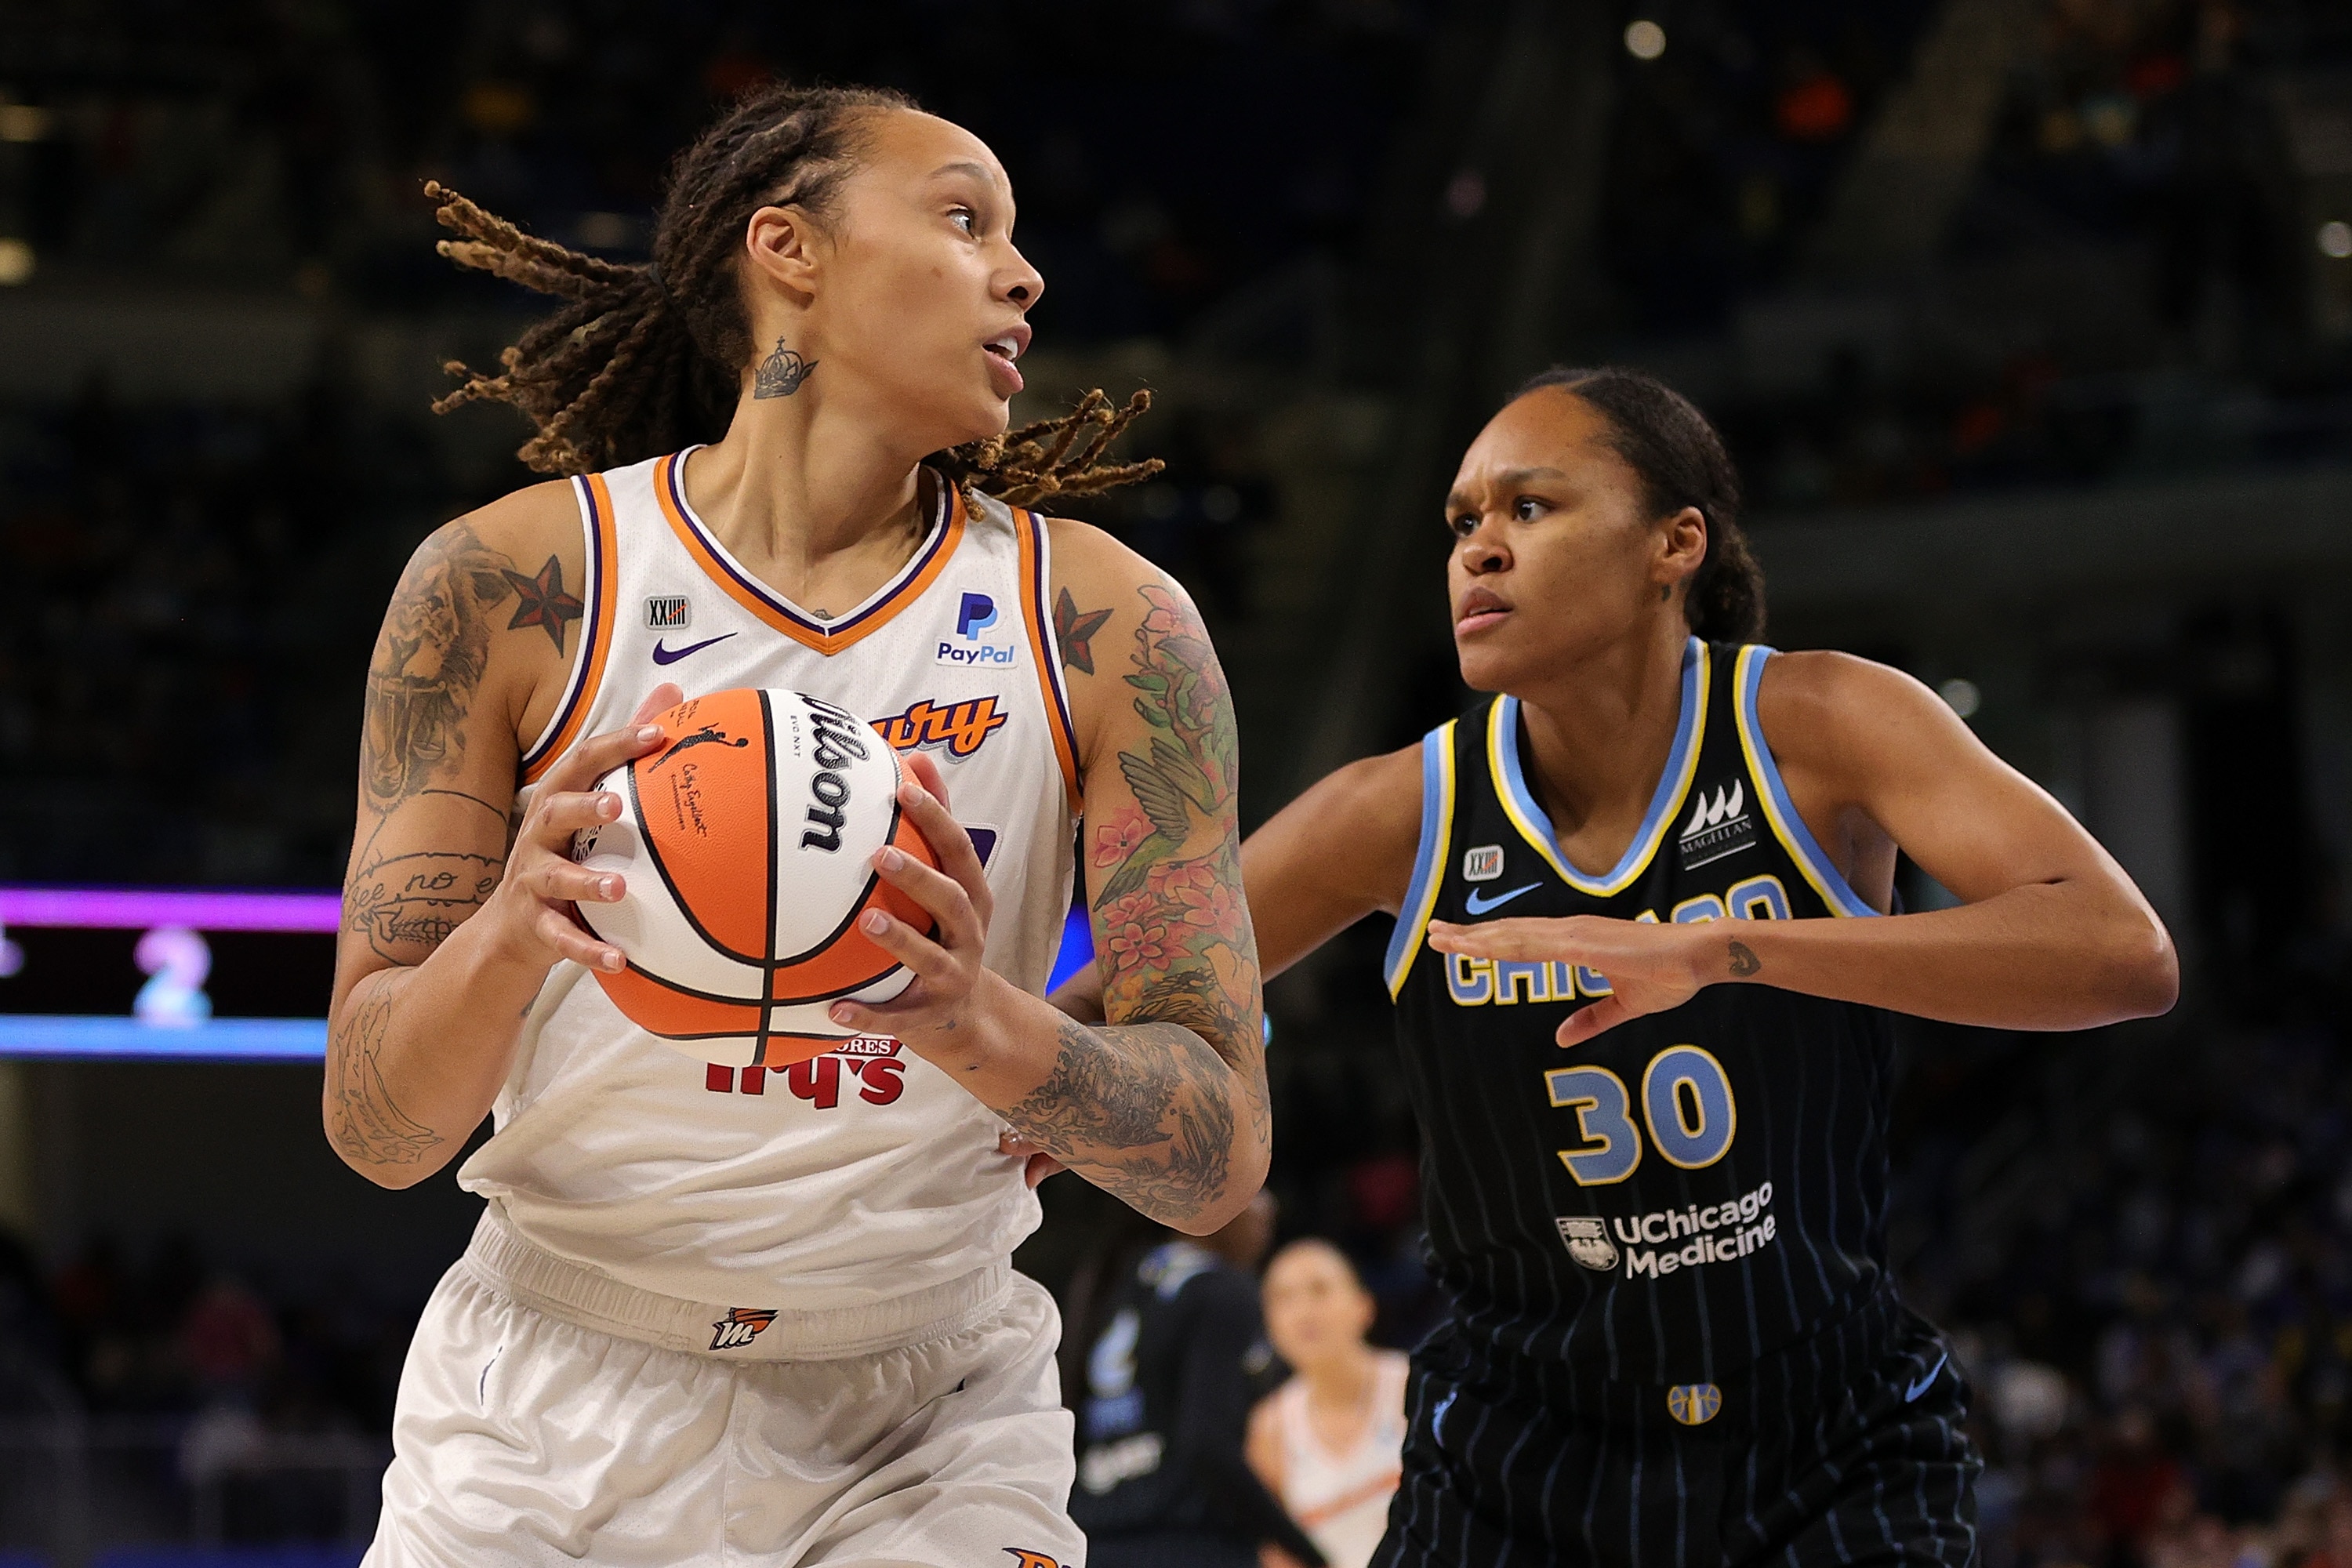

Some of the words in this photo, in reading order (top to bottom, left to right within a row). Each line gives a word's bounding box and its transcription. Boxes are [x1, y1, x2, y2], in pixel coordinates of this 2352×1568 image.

[937, 641, 1014, 665] PayPal
[1680, 818, 1753, 854] MAGELLAN
[405, 872, 459, 892] no
[1544, 1044, 1737, 1185] 30
[1613, 1179, 1773, 1245] UChicago
[1626, 1214, 1777, 1280] Medicine
